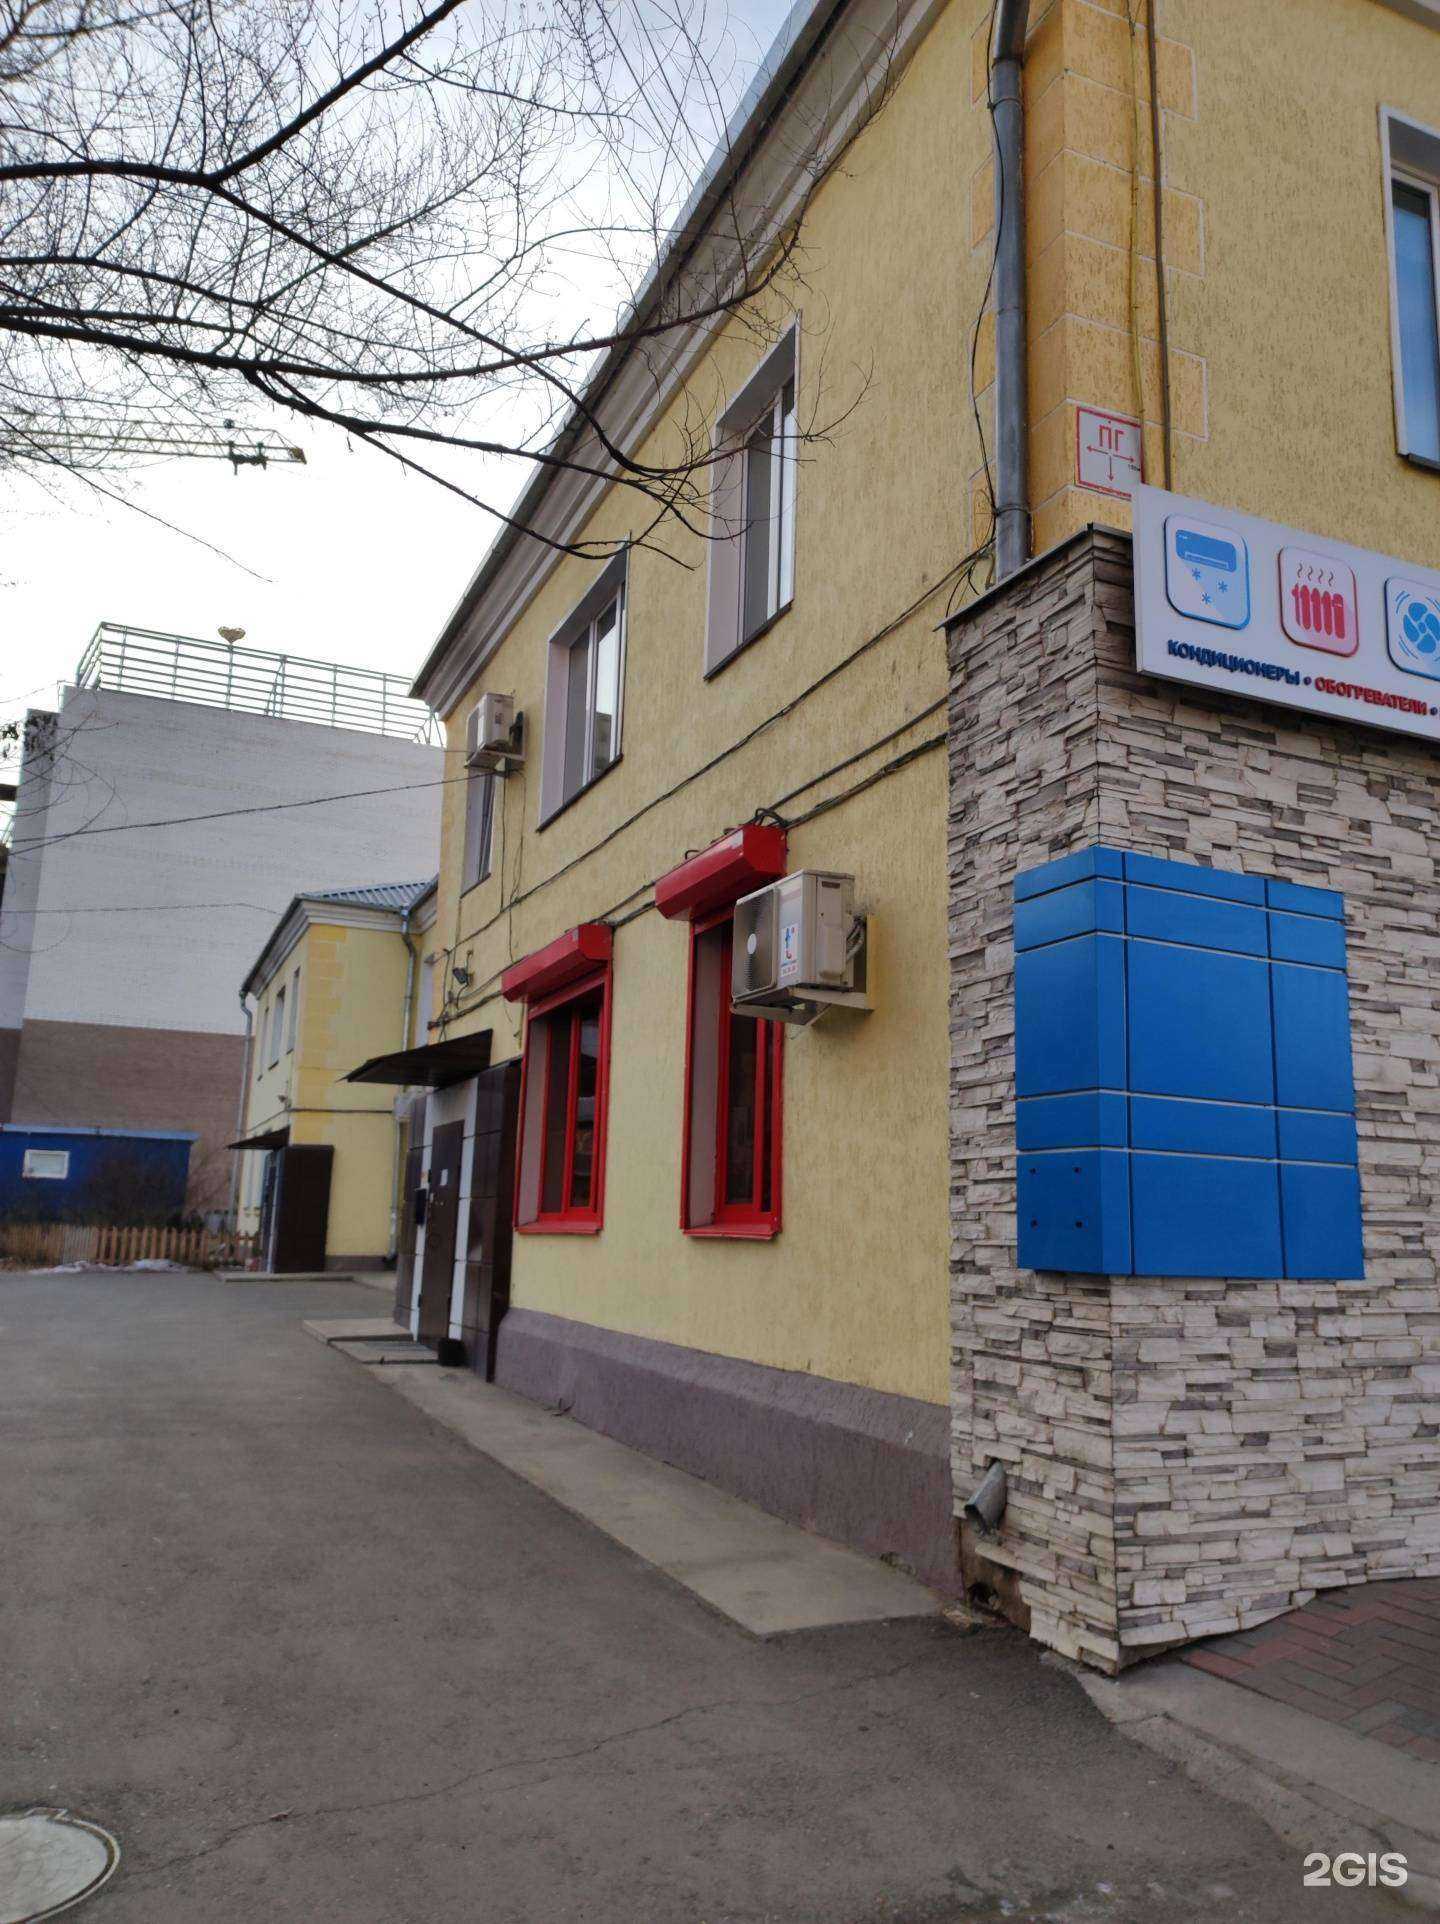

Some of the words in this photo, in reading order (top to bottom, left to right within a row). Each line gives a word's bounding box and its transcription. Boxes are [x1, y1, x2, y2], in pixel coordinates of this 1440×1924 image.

[1099, 424, 1124, 452] ПГ
[1167, 639, 1300, 685] КОНДИЦИОНЕРЫ
[1314, 676, 1428, 715] ОБОГРЕВАТЕЛИ
